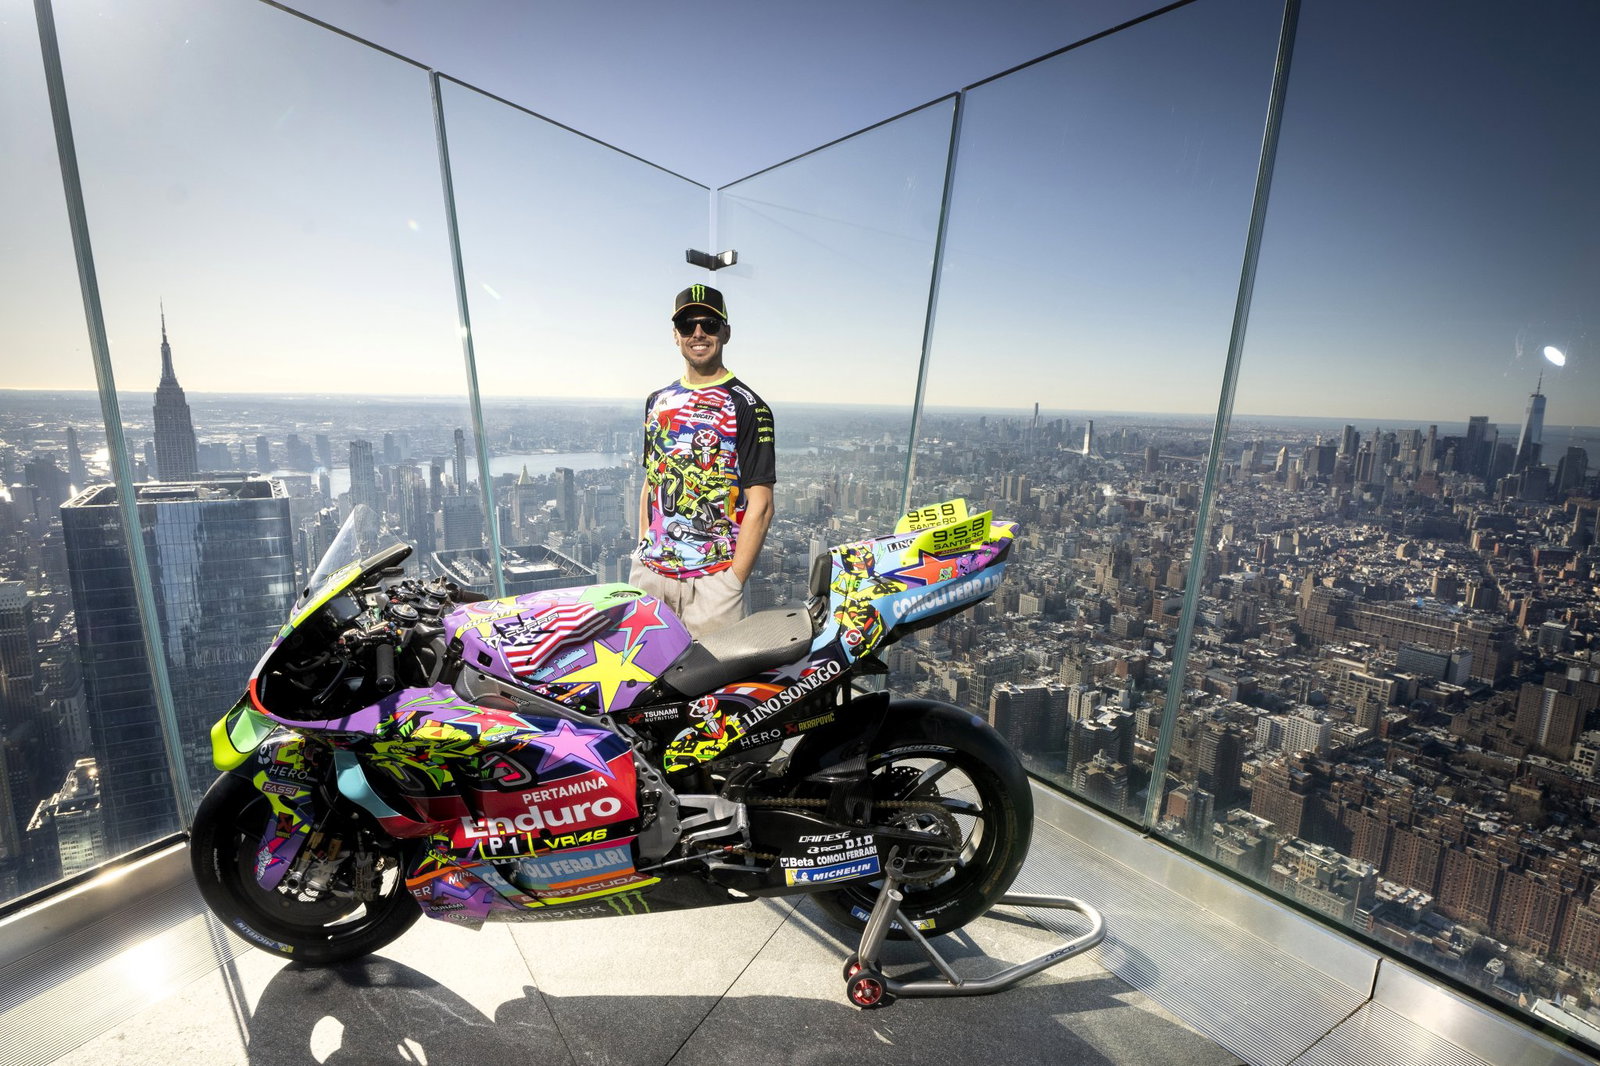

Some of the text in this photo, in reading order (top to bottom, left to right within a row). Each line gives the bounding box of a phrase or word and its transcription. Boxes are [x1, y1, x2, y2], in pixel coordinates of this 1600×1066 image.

[692, 412, 715, 421] DUCATI
[892, 587, 948, 619] COMOLI
[506, 612, 560, 637] CUPRA
[743, 660, 842, 727] LINO SONEGO
[644, 708, 678, 718] TSUNAMI
[645, 714, 680, 722] NUTRITION
[740, 728, 782, 747] HERO
[269, 765, 308, 780] HERO
[264, 784, 296, 795] FASSI
[522, 776, 608, 805] PERTAMINA
[460, 796, 622, 839] Enduro
[489, 835, 520, 855] P 1
[798, 831, 851, 843] DAINESE
[552, 848, 629, 877] FERRARI
[790, 845, 878, 867] Beta COMOLI FERRARI
[812, 862, 871, 881] MICHELIN
[521, 875, 643, 902] BARRACUDA
[504, 905, 607, 923] MONSTER
[236, 921, 275, 948] MICHELIN
